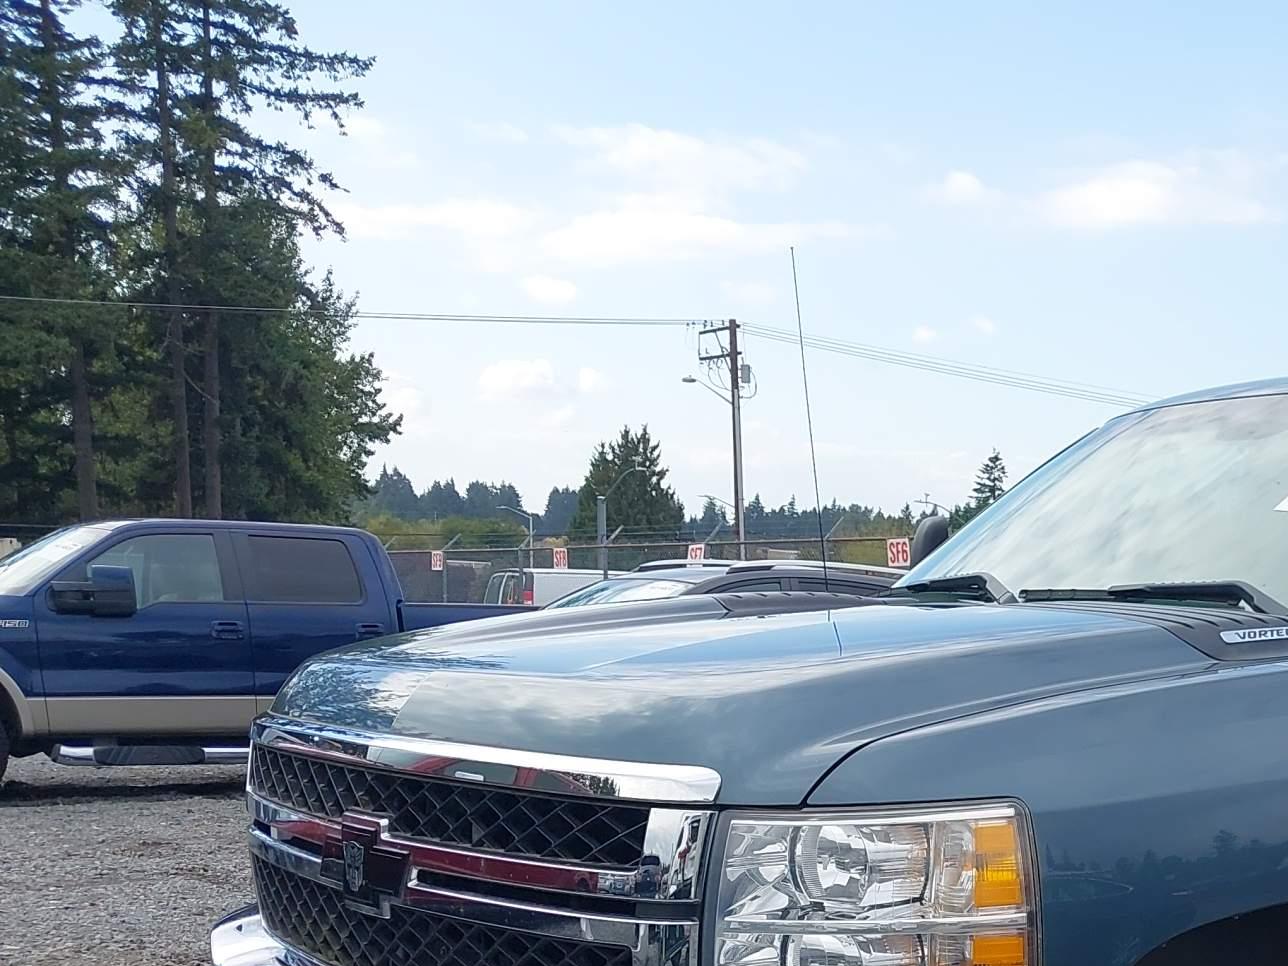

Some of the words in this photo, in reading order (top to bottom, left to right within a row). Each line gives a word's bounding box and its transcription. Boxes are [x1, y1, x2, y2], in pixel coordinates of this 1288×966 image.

[432, 552, 443, 569] SF9
[555, 549, 567, 567] SF8
[889, 541, 909, 563] SF6
